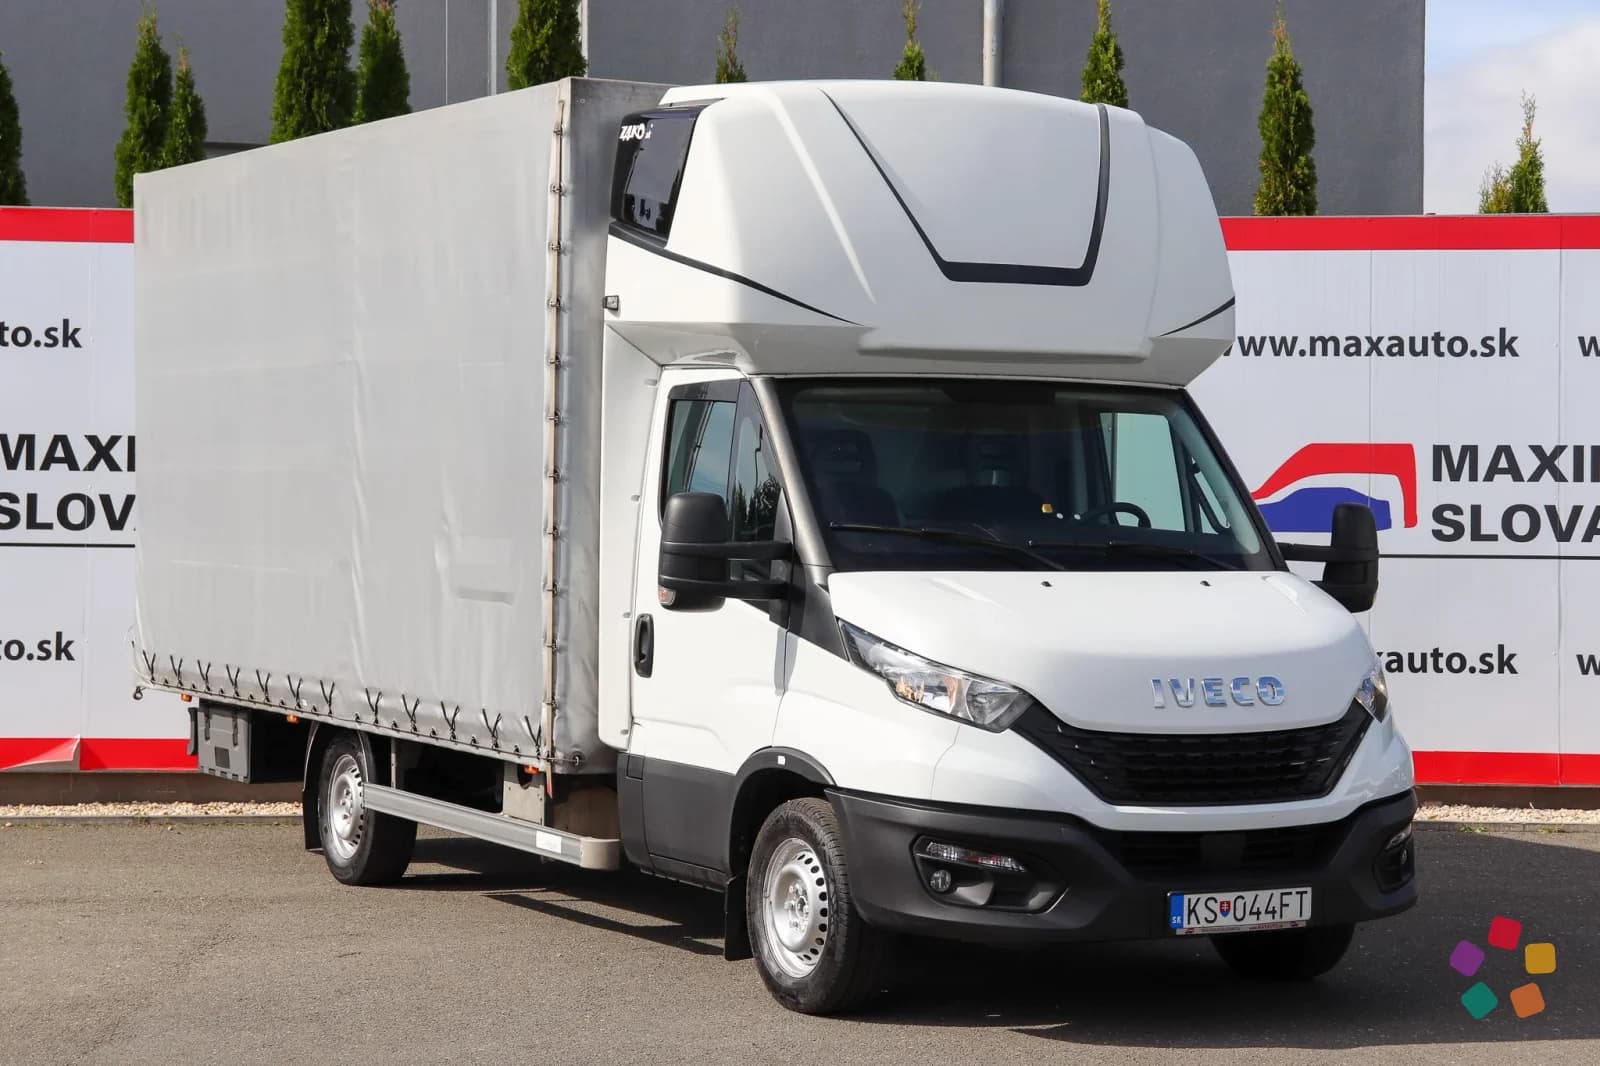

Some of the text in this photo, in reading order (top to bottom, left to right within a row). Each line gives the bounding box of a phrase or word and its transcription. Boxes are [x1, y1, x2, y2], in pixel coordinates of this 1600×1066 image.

[1223, 327, 1520, 357] ww.maxauto.sk
[0, 433, 136, 472] MAXI
[1432, 444, 1600, 483] MAXI
[0, 492, 136, 531] SLOV
[0, 631, 76, 661] o.sk
[1376, 644, 1519, 675] auto.sk
[1151, 676, 1286, 709] IVECO
